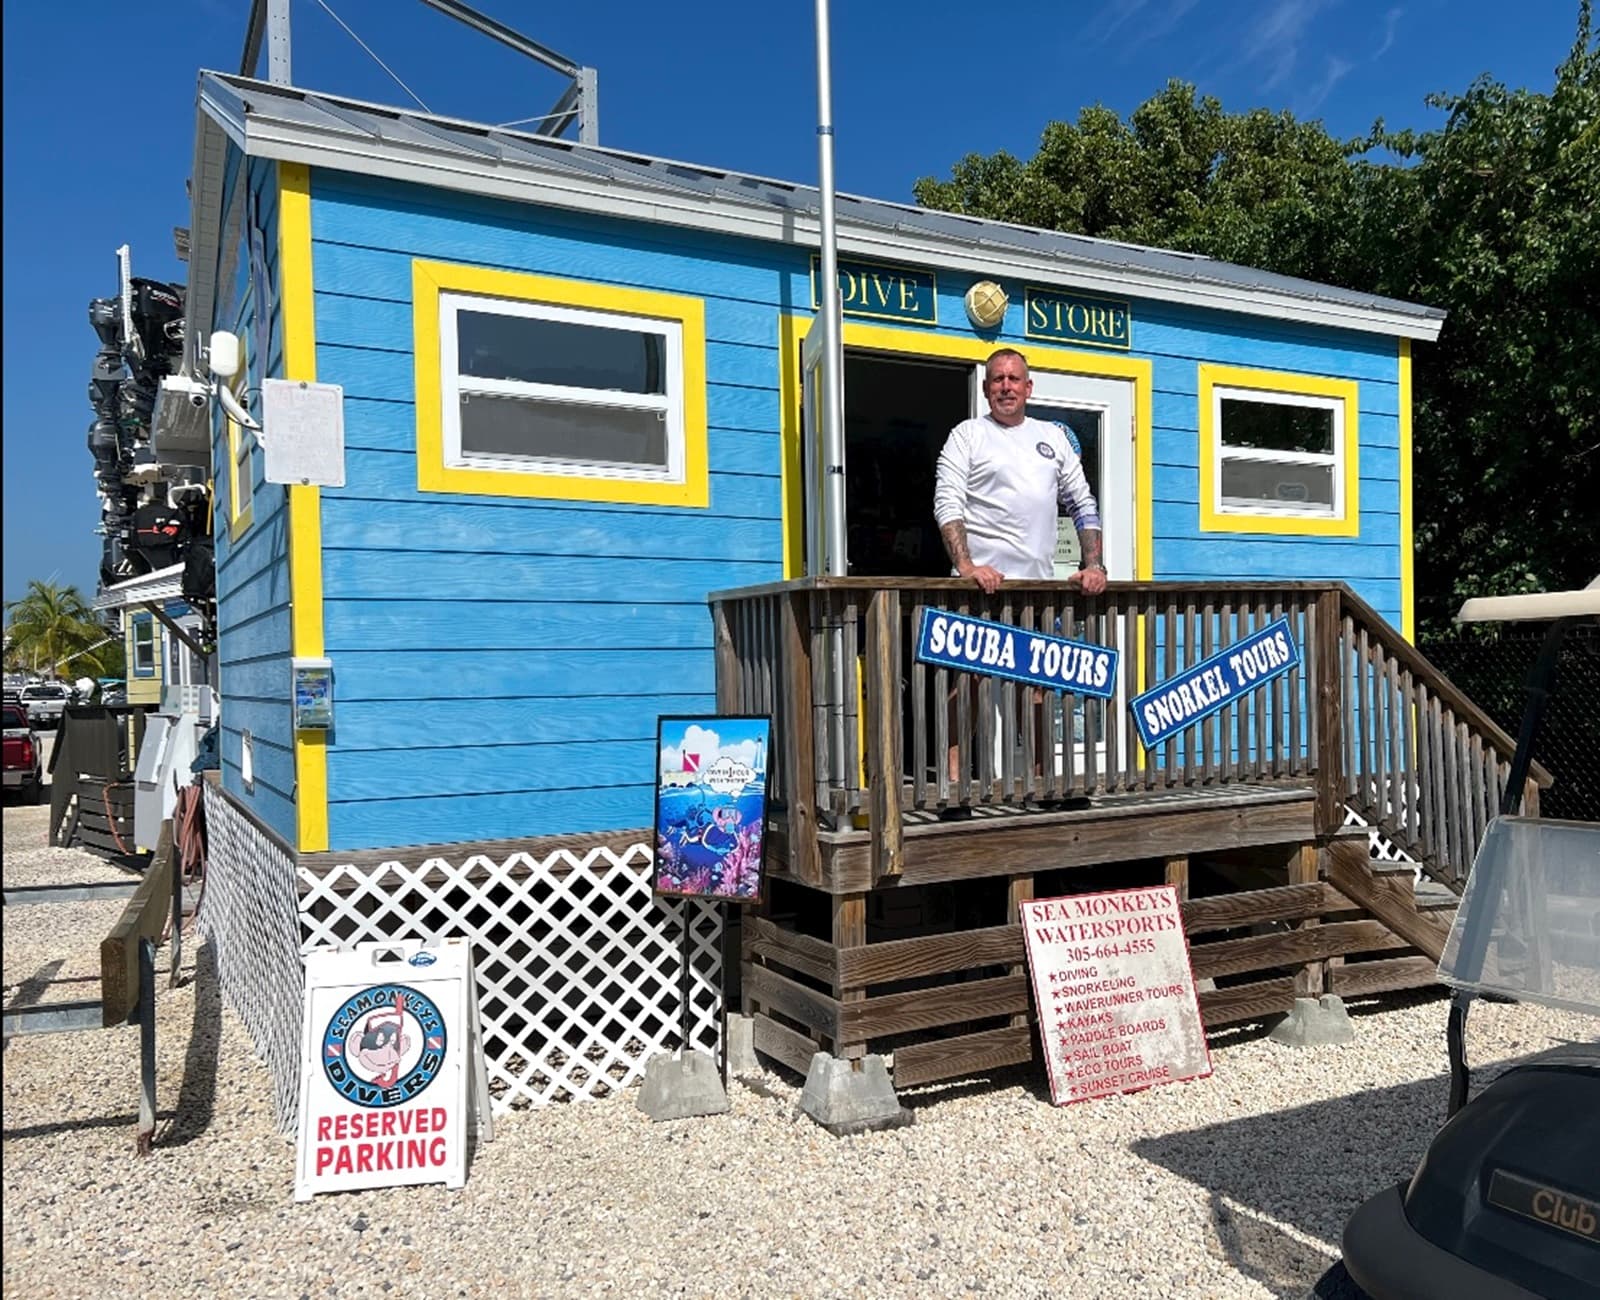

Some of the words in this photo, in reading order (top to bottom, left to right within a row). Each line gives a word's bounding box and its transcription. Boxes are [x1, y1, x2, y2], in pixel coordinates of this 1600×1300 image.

[836, 269, 919, 312] DIVE
[1031, 296, 1126, 340] STORE
[930, 617, 1016, 669] SCUBA
[1029, 642, 1109, 688] TOURS
[1143, 666, 1230, 735] SNORKEL
[1229, 629, 1290, 687] TOURS
[1032, 901, 1071, 923] SEA
[1075, 890, 1172, 918] MONKEYS
[1035, 913, 1176, 945] WATERSPORTS
[1066, 938, 1156, 964] 305-664-4555
[1058, 966, 1098, 982] DIVING
[1062, 976, 1136, 998] SNORKELING
[1064, 990, 1144, 1013] WAVERUNNER
[1146, 984, 1184, 1000] TOURS
[1067, 1012, 1114, 1029] KAYAKS
[1070, 1028, 1117, 1045] PADDLE
[1119, 1019, 1166, 1037] BOARDS
[1073, 1048, 1100, 1061] SAIL
[1102, 1040, 1132, 1056] BOAT
[327, 1053, 440, 1103] DIVERS
[1077, 1062, 1101, 1078] ECO
[1104, 1055, 1143, 1071] TOURS
[1080, 1075, 1126, 1094] SUNSET
[1128, 1066, 1170, 1082] CRUISE
[317, 1107, 448, 1142] RESERVED
[316, 1137, 447, 1177] PARKING
[1533, 1190, 1597, 1234] Club
